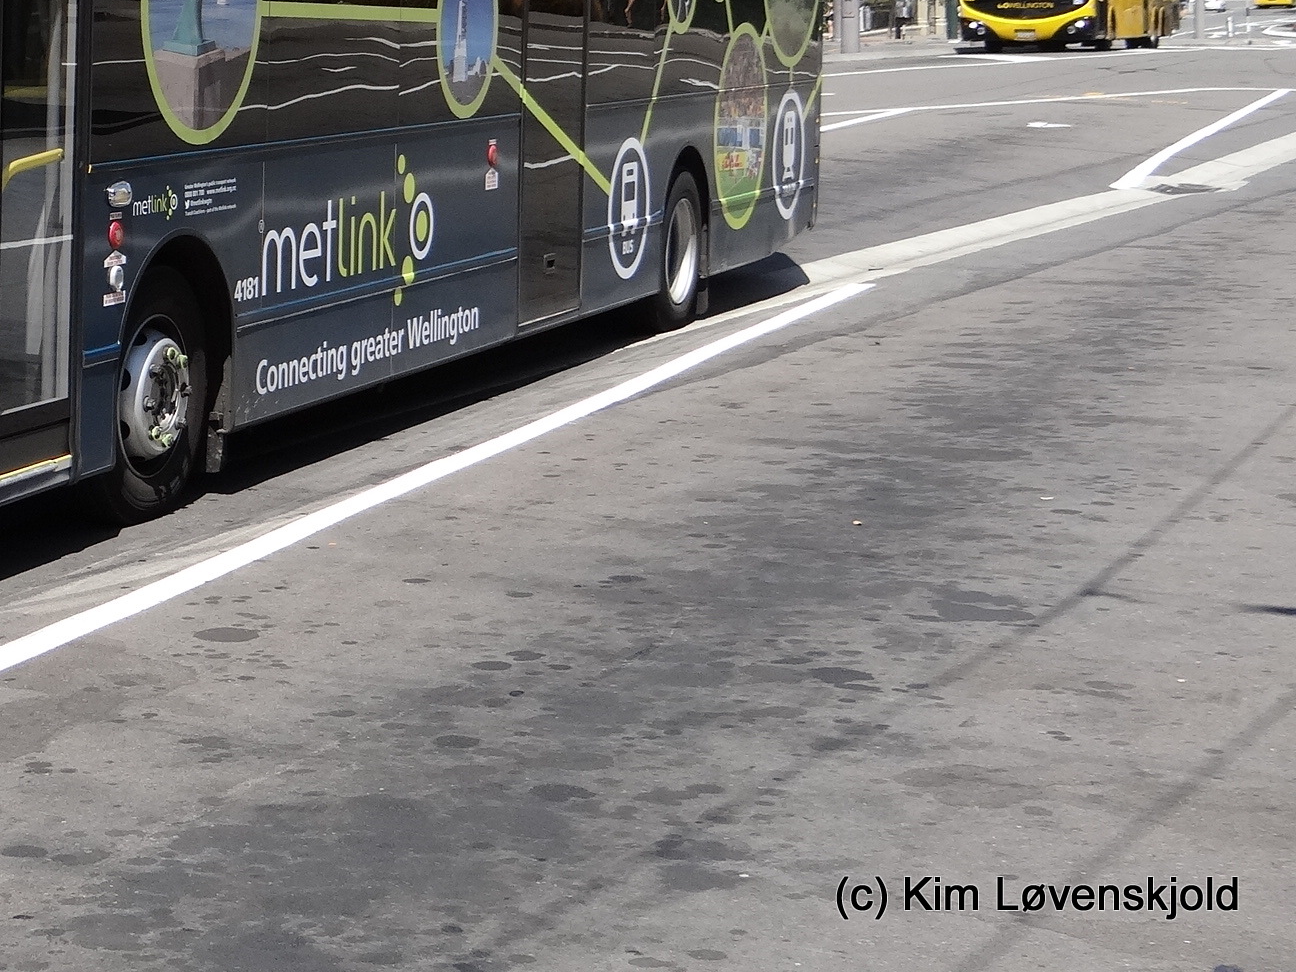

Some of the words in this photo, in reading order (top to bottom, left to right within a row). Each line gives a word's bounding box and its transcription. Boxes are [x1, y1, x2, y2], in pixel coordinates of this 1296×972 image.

[132, 193, 168, 217] metlink
[261, 190, 397, 297] metlink
[622, 239, 635, 256] BUS
[234, 276, 259, 302] 4181
[255, 340, 347, 395] Connecting
[351, 327, 405, 376] greater
[407, 306, 480, 350] Wellington
